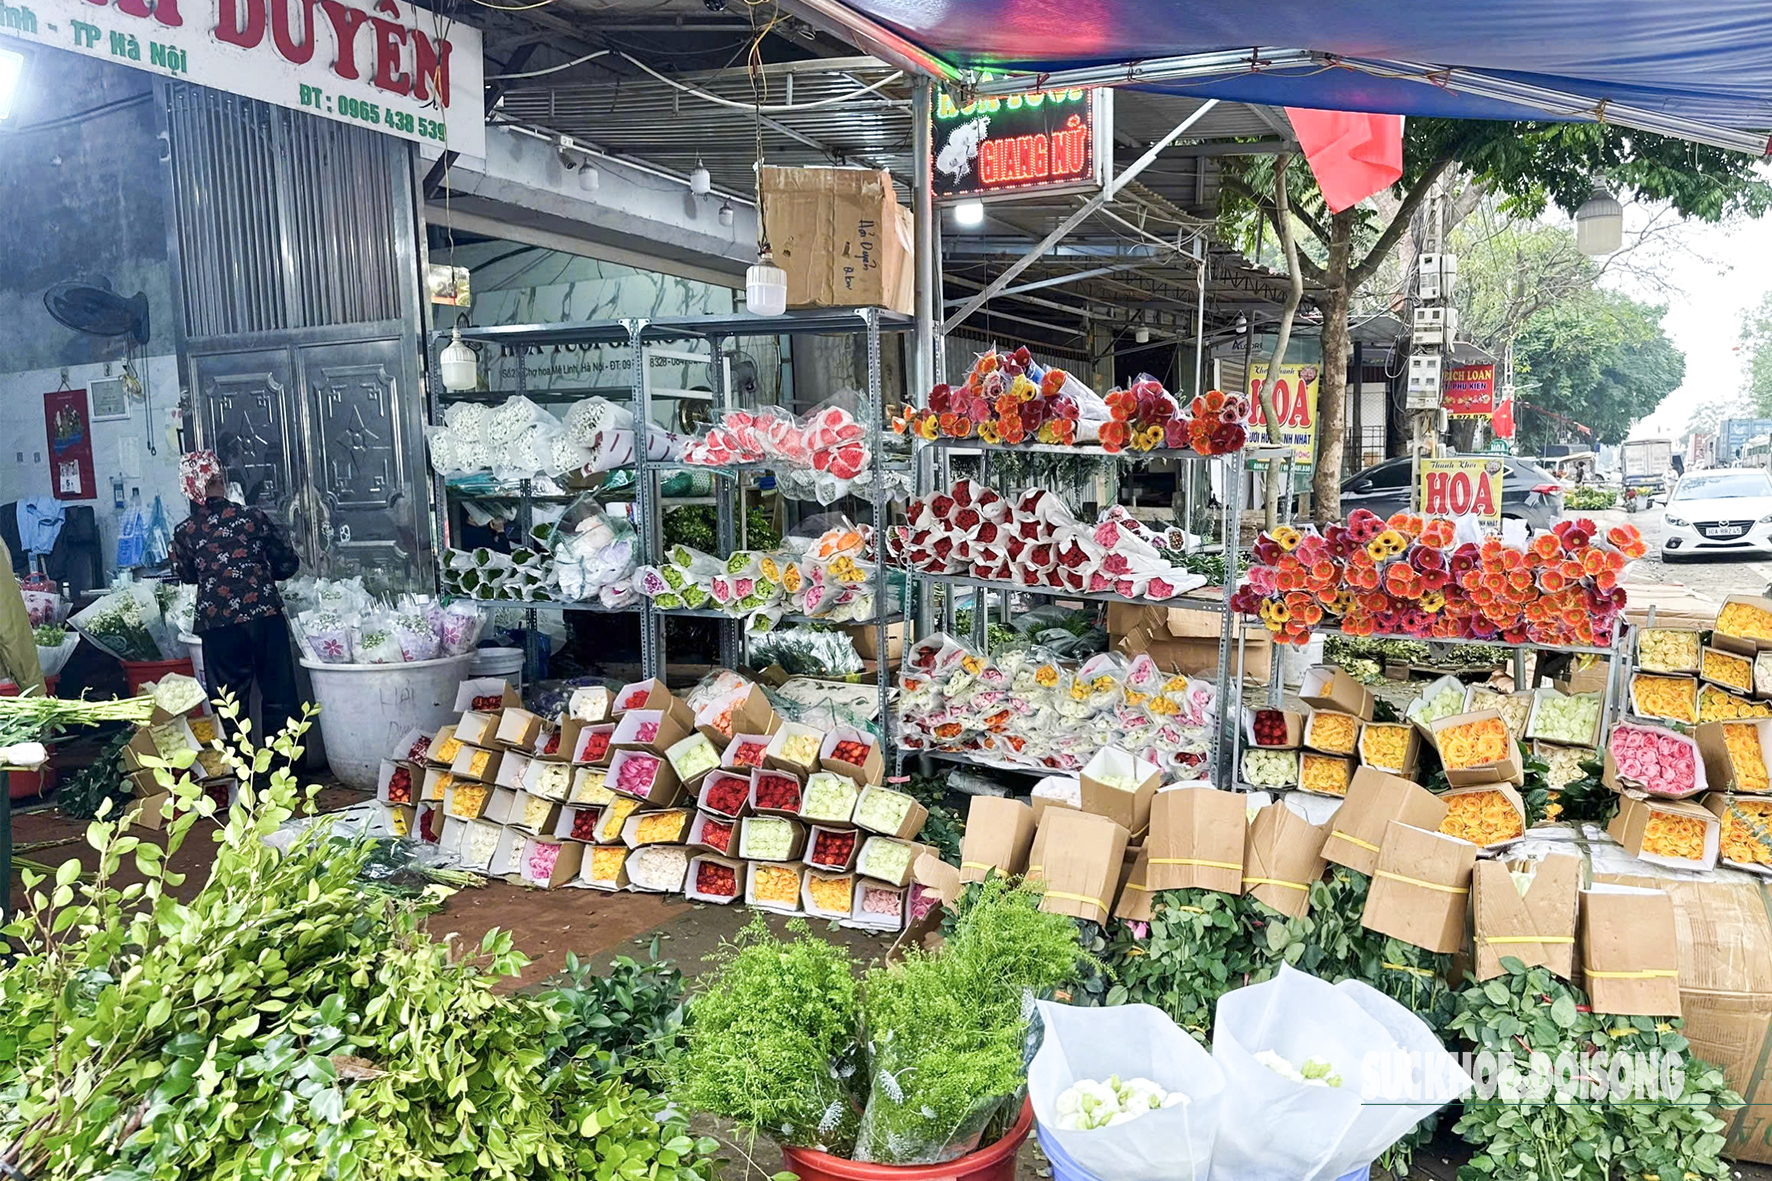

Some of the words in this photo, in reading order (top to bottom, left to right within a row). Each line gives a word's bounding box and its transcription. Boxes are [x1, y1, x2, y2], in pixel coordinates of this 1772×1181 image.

[71, 19, 102, 49] TP
[109, 30, 141, 61] Hà
[150, 41, 188, 76] Nội
[337, 95, 380, 125] 0965
[384, 108, 415, 133] 438
[418, 116, 446, 143] 539
[980, 133, 1049, 183] GIANG
[539, 366, 551, 377] hoa
[1467, 369, 1492, 381] LOAN
[1425, 471, 1497, 517] HOA
